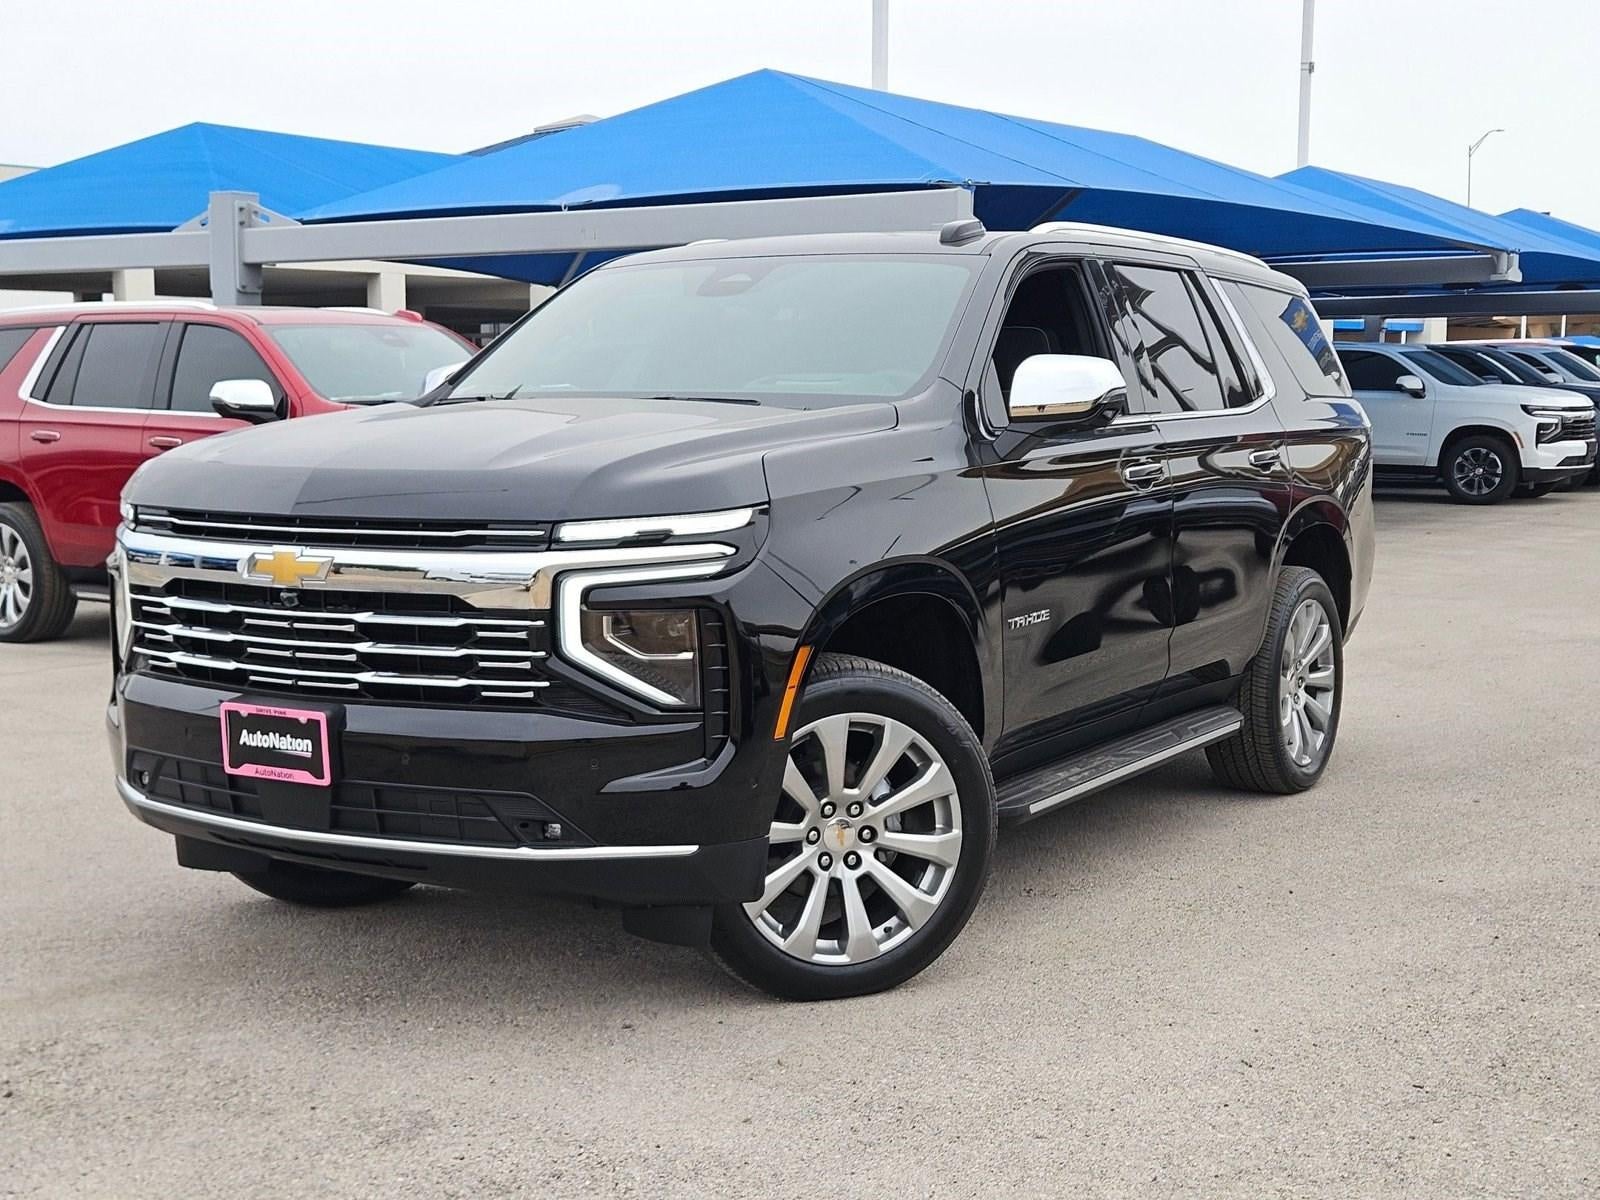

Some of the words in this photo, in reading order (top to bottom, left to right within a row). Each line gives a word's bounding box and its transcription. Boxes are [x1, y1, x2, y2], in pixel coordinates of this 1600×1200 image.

[1007, 609, 1051, 631] TAHOE
[239, 728, 313, 753] AutoNation
[254, 767, 295, 779] AutoNation
